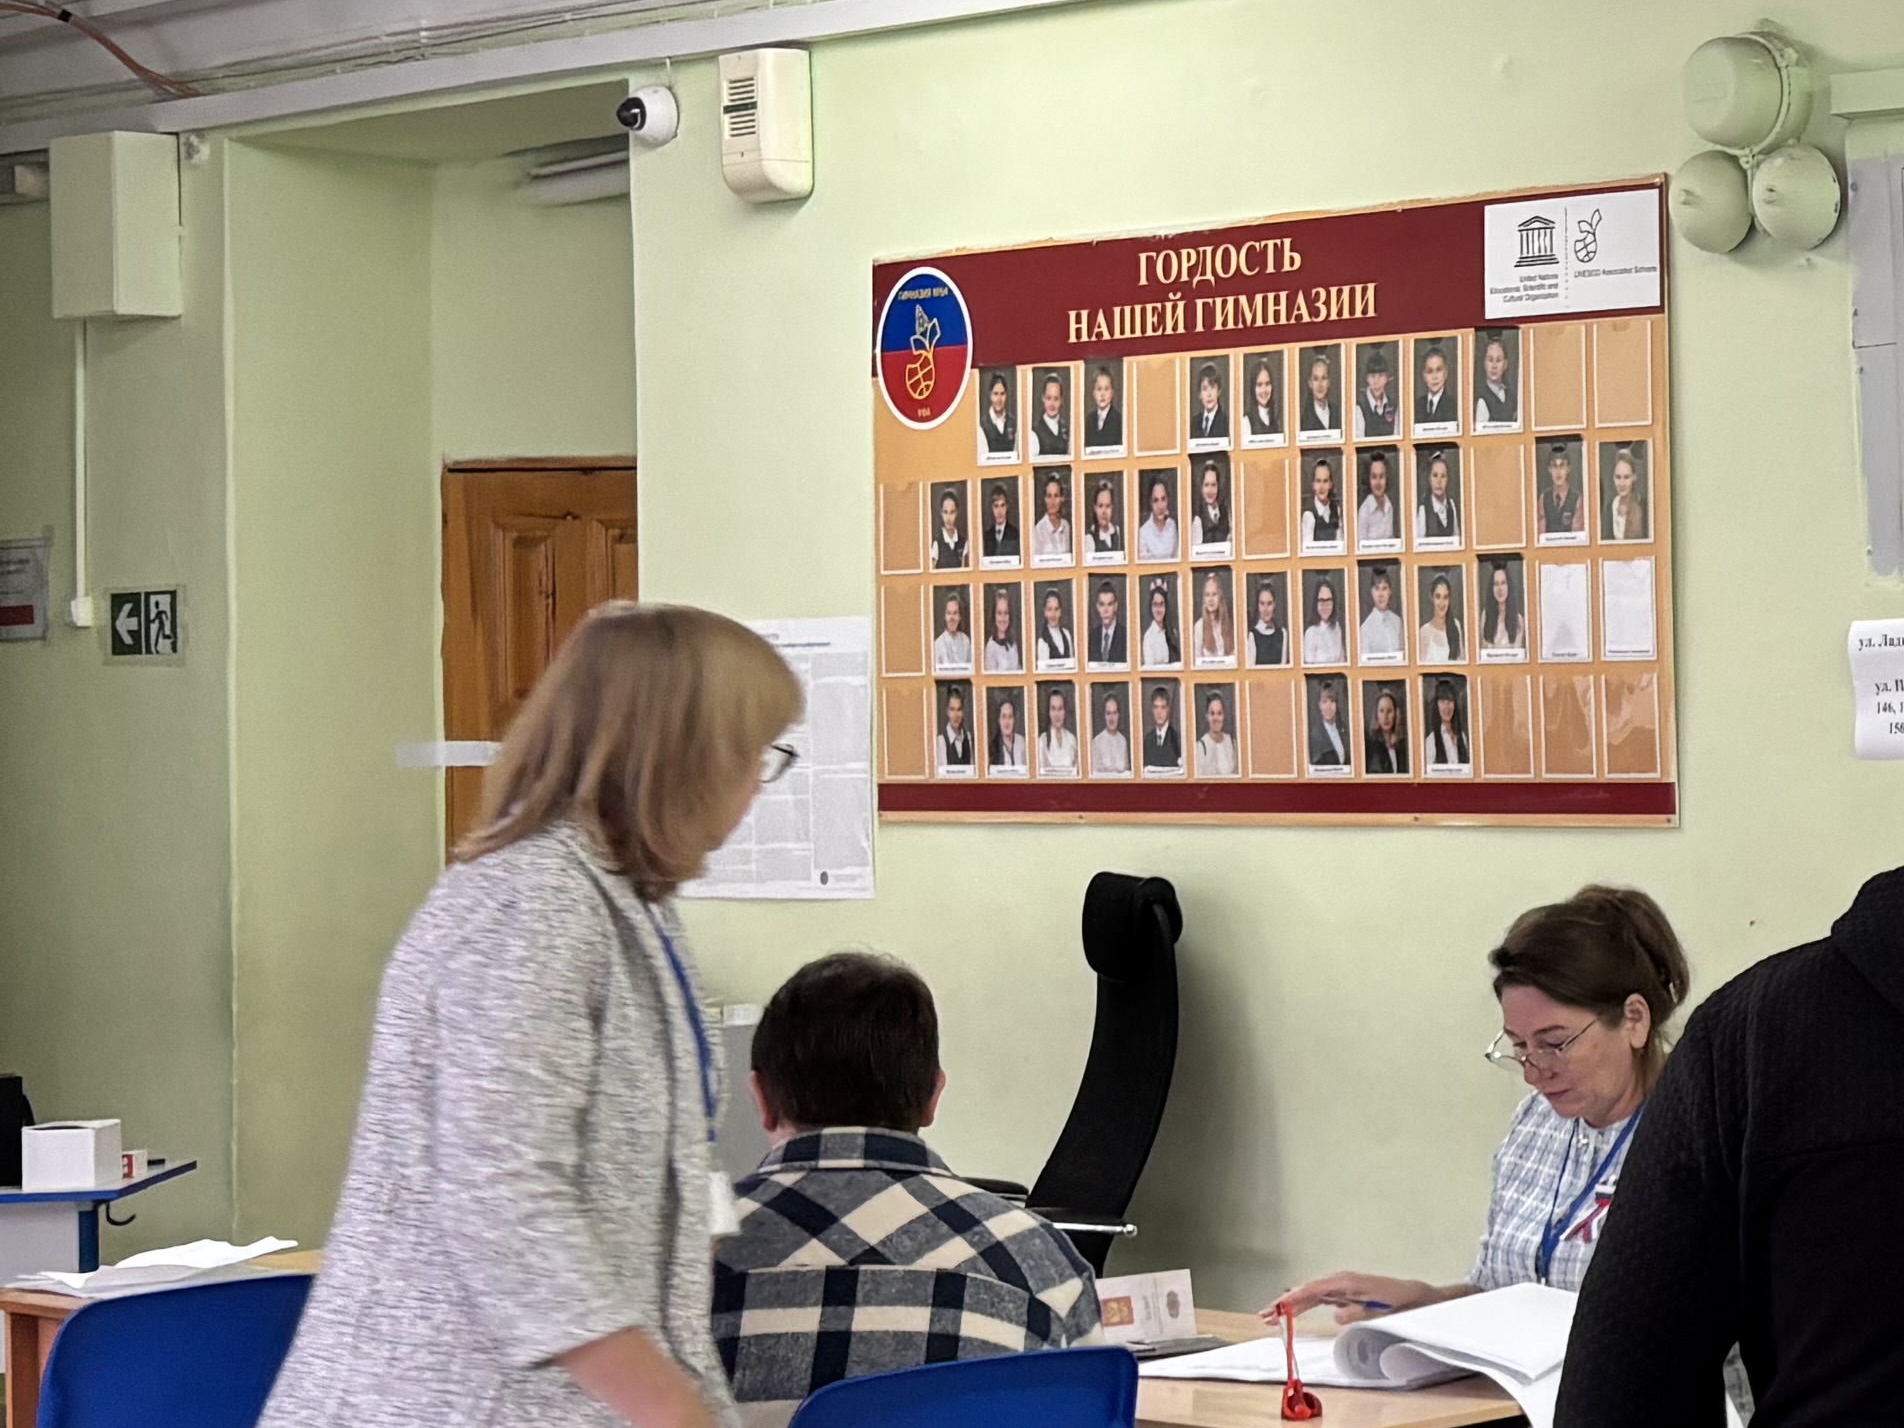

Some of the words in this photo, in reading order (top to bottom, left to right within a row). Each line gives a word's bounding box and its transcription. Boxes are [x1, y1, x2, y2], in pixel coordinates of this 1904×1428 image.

[1138, 238, 1302, 288] ГОРДОСТЬ
[1067, 292, 1187, 343] НАШЕЙ
[1194, 282, 1379, 332] ГИМНАЗИИ
